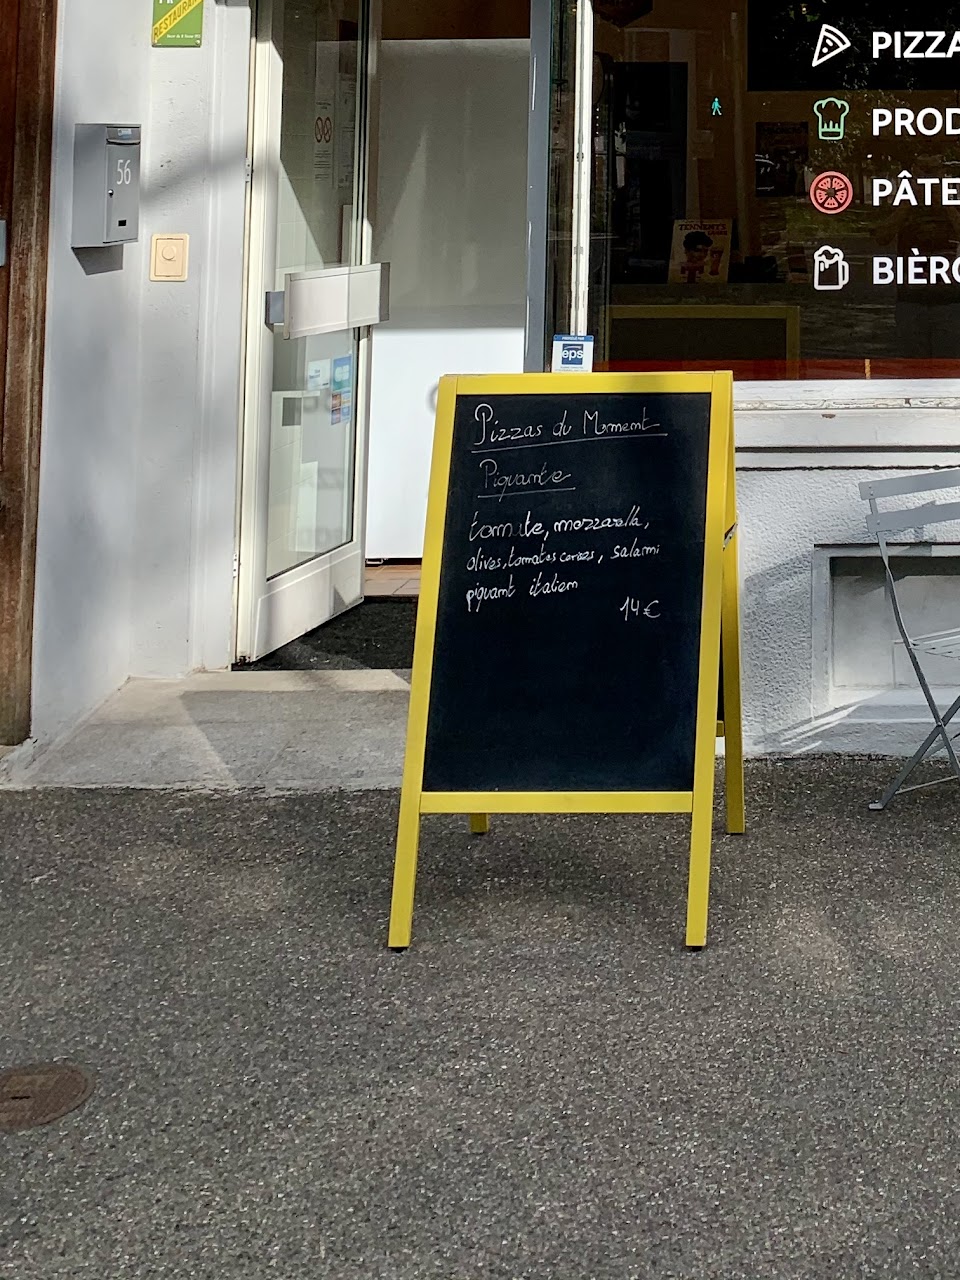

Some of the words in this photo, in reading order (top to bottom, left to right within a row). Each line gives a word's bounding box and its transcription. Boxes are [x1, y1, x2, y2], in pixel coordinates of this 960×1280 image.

[116, 159, 131, 185] 56
[873, 170, 960, 205] PÂTE
[562, 350, 584, 361] eps
[473, 403, 544, 445] Pizzas
[552, 410, 573, 437] du
[583, 407, 660, 435] Moment
[479, 458, 571, 502] Piquante
[610, 537, 660, 560] salami
[466, 574, 516, 612] piquant
[529, 571, 578, 597] italien
